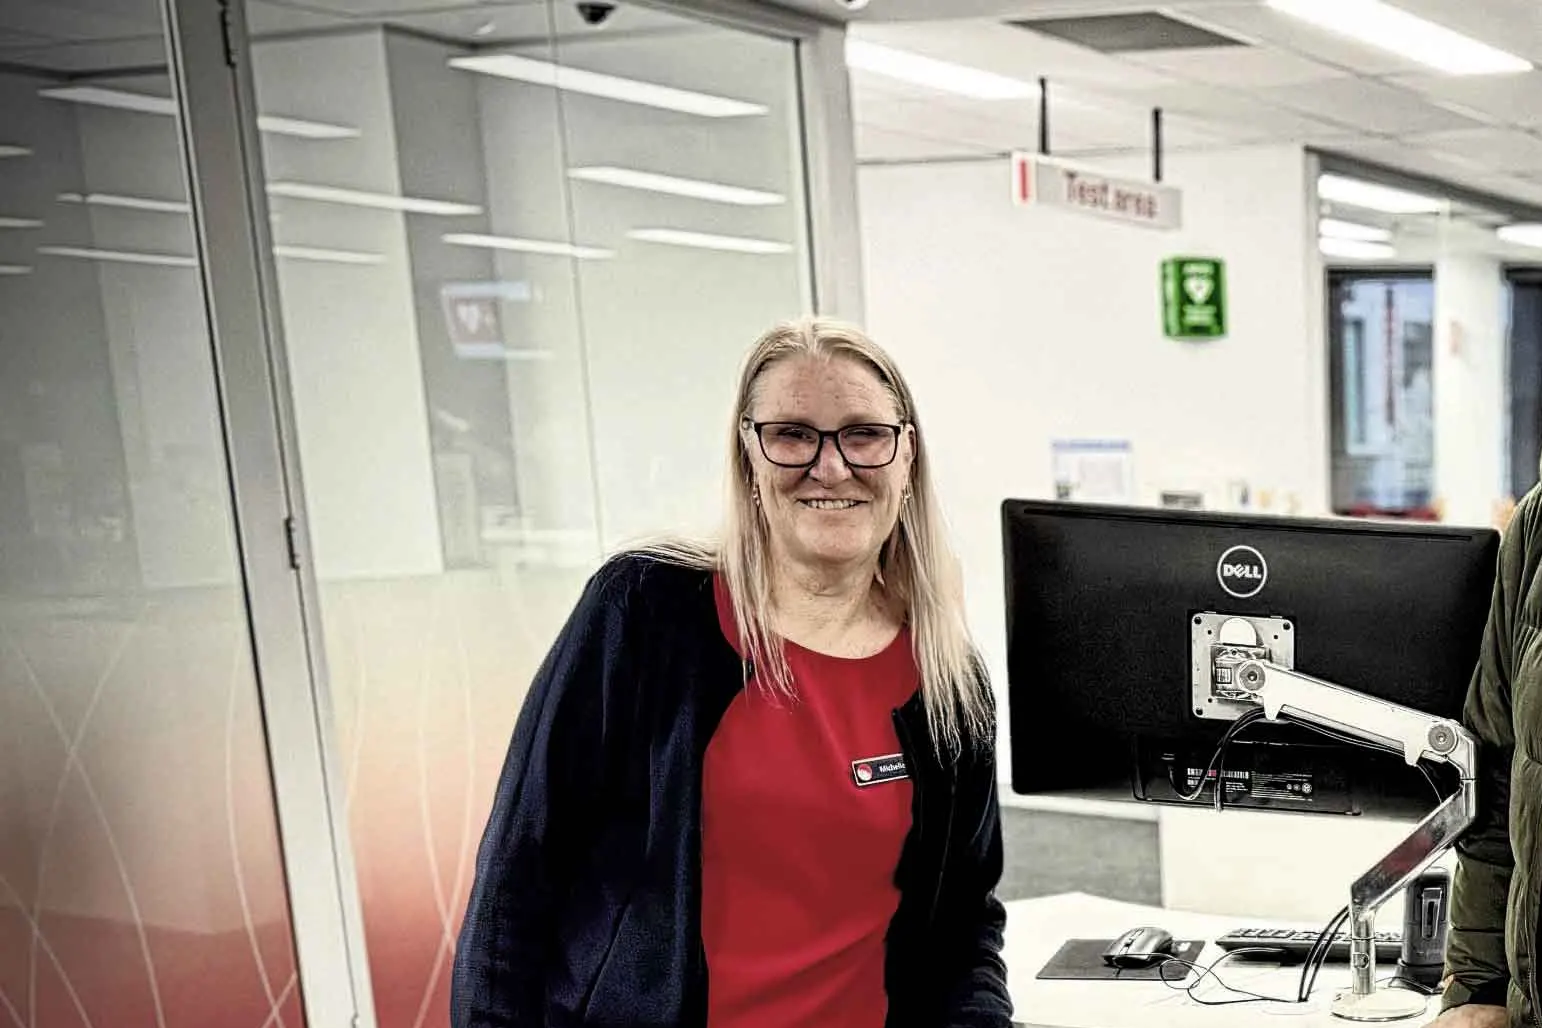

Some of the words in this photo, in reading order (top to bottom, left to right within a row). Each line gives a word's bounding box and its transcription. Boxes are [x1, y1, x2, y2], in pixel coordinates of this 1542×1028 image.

[1065, 171, 1109, 209] Test
[1115, 188, 1157, 219] area
[1223, 564, 1262, 579] DELL
